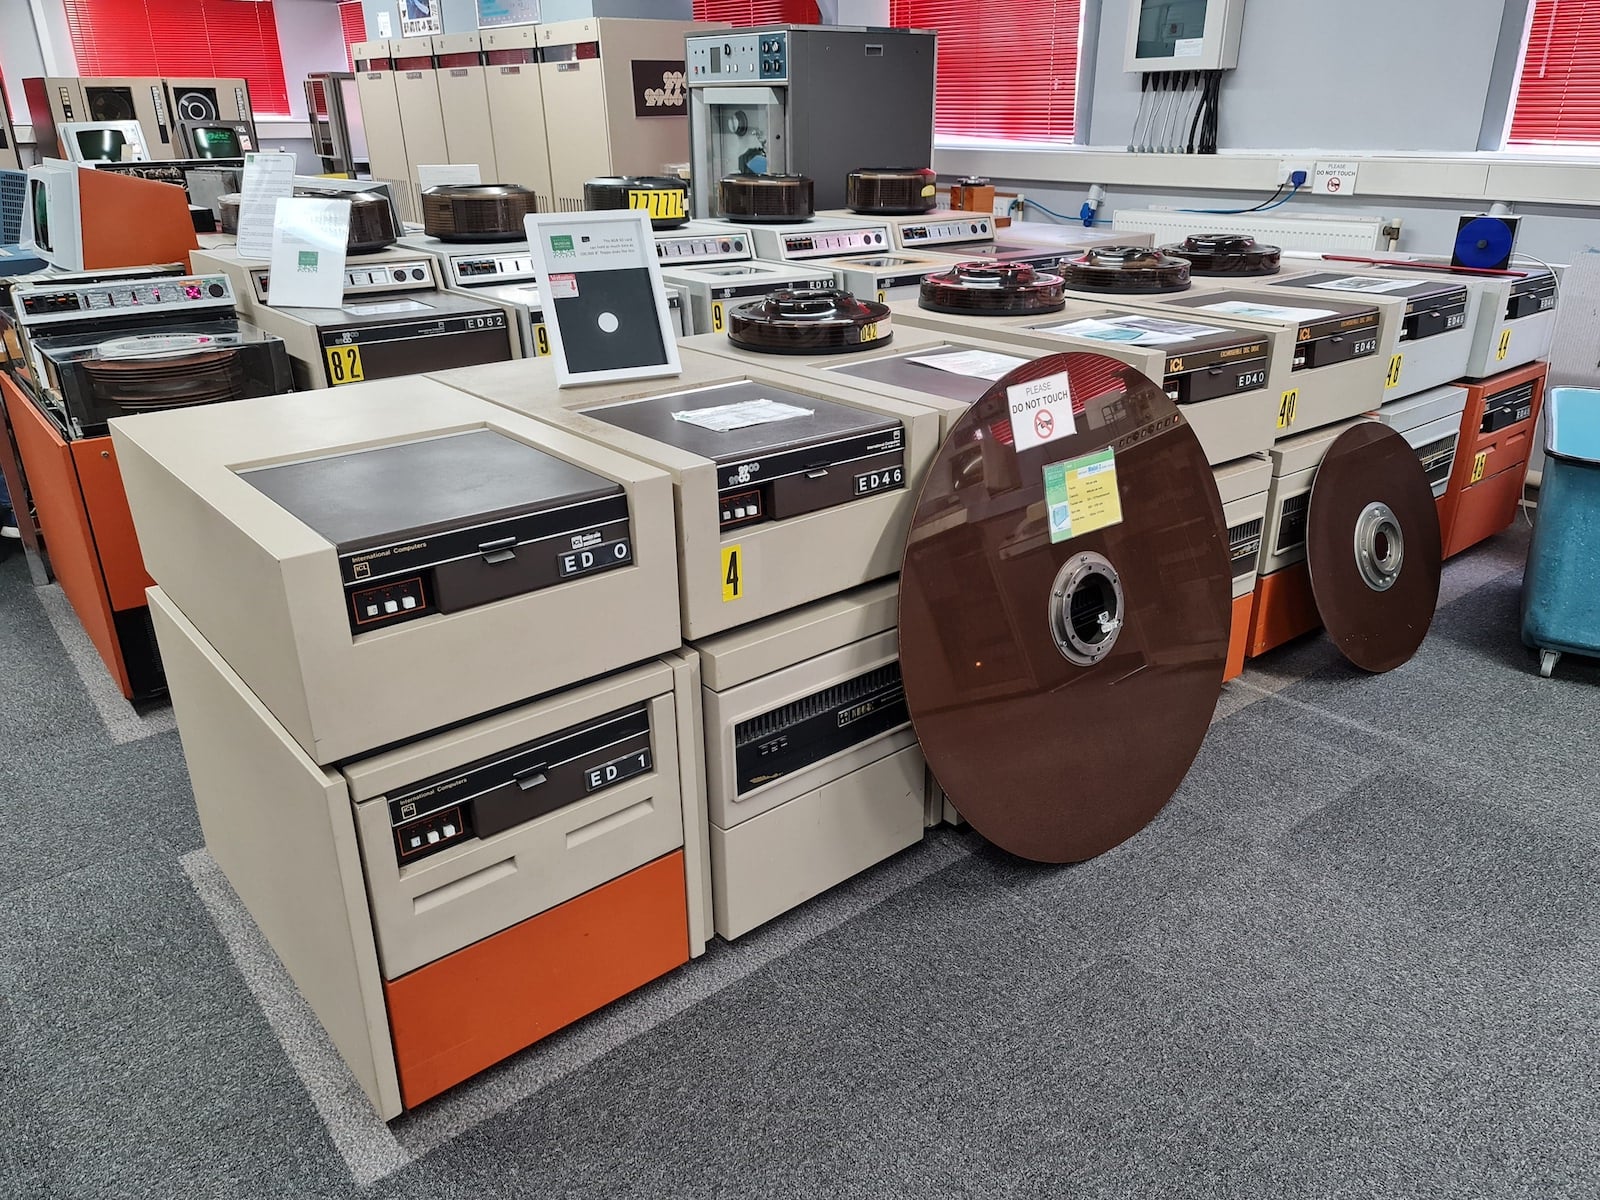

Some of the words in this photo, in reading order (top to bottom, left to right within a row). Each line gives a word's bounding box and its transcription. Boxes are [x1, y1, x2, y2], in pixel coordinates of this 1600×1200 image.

[810, 280, 834, 290] ED90
[468, 317, 503, 329] ED82
[714, 305, 722, 330] 9
[538, 327, 548, 354] 9
[1300, 328, 1311, 340] ICL
[1354, 340, 1376, 353] ED42
[332, 348, 360, 380] 82
[1170, 358, 1184, 372] ICL
[1238, 372, 1264, 387] ED40
[1026, 382, 1052, 396] PLEASE
[1012, 403, 1024, 414] DO
[1025, 397, 1041, 410] NOT
[1042, 390, 1069, 405] TOUCH
[859, 469, 902, 491] ED46
[352, 550, 391, 563] International
[393, 542, 427, 554] Computers
[356, 564, 367, 572] ICL
[726, 551, 739, 596] 4
[638, 754, 645, 767] 1
[400, 789, 435, 805] International
[437, 778, 468, 792] Computers
